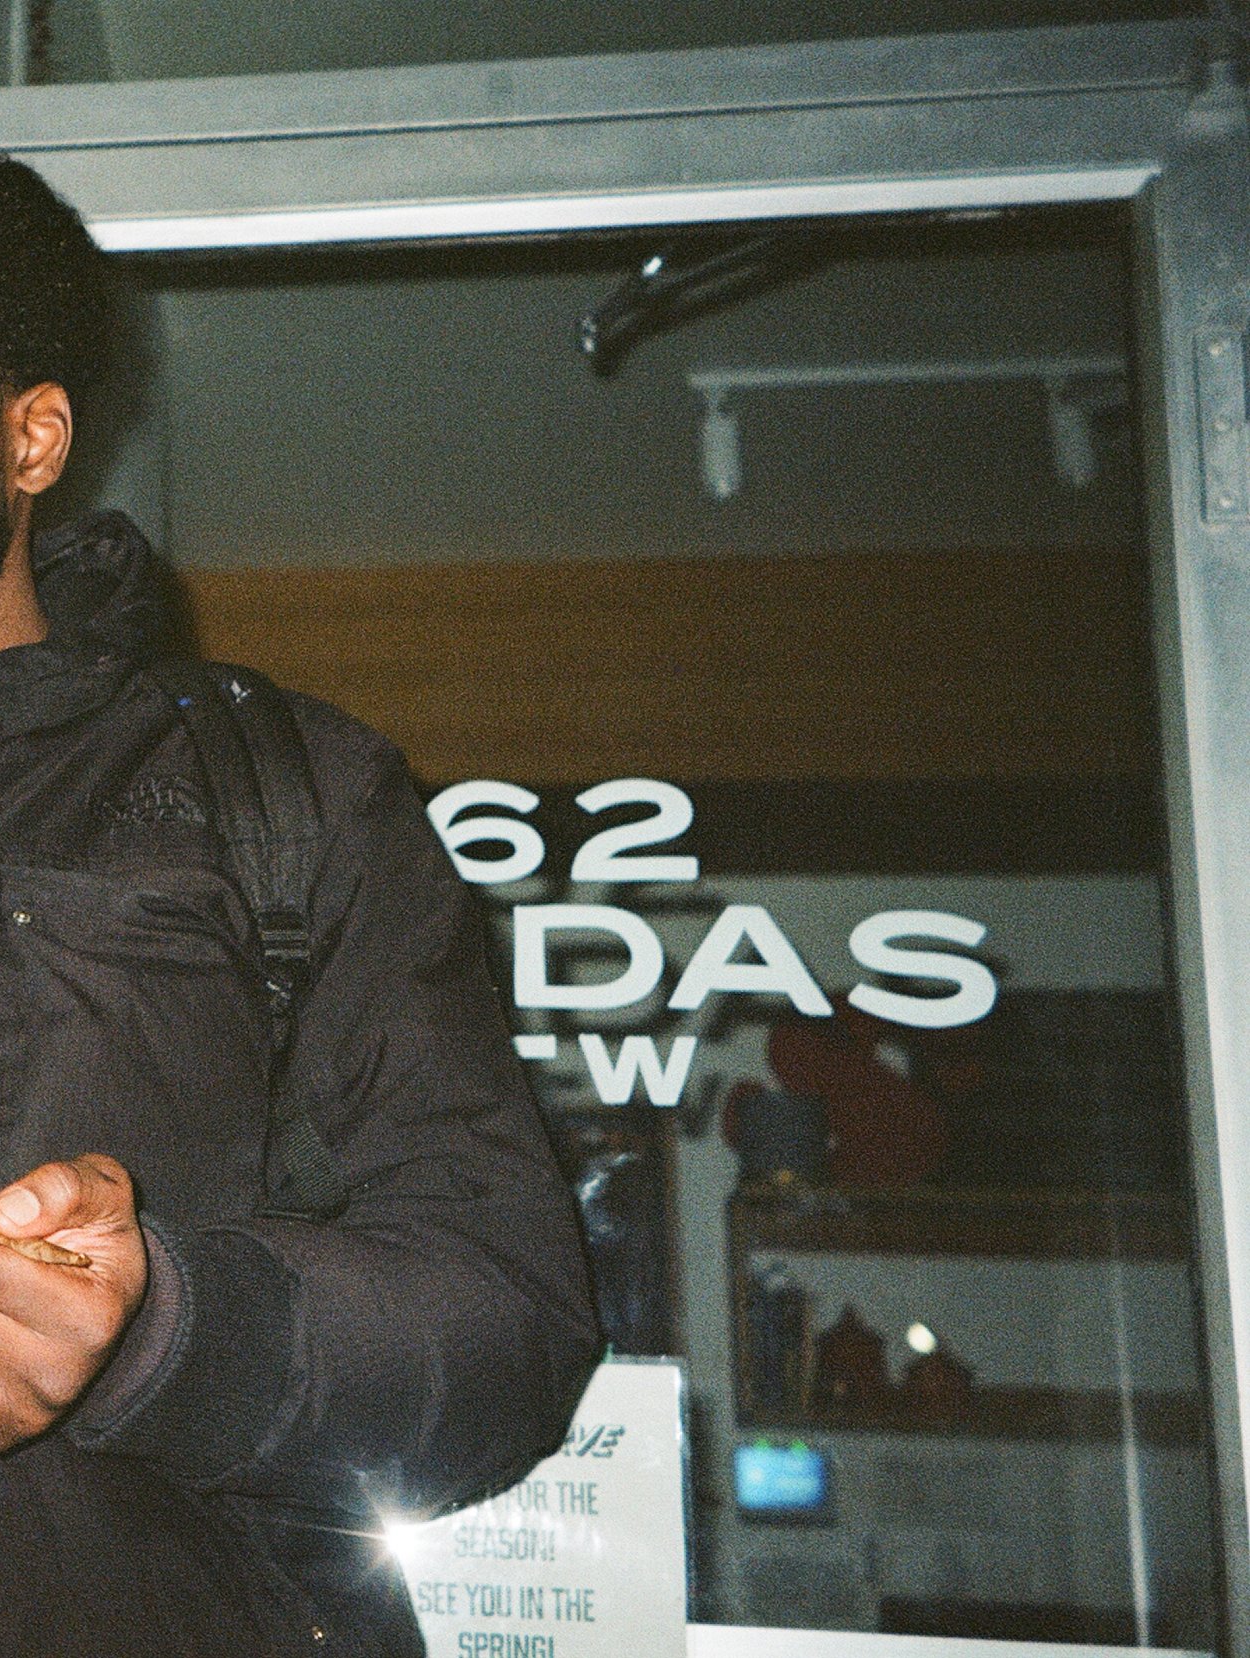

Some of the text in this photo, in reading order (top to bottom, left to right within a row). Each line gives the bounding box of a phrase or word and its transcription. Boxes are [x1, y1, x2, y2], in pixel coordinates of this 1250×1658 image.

[427, 778, 699, 884] 62
[513, 904, 997, 1029] DAS
[555, 1481, 598, 1515] THE
[454, 1525, 555, 1561] SEASON!
[417, 1582, 595, 1622] SEE YOU IN THE
